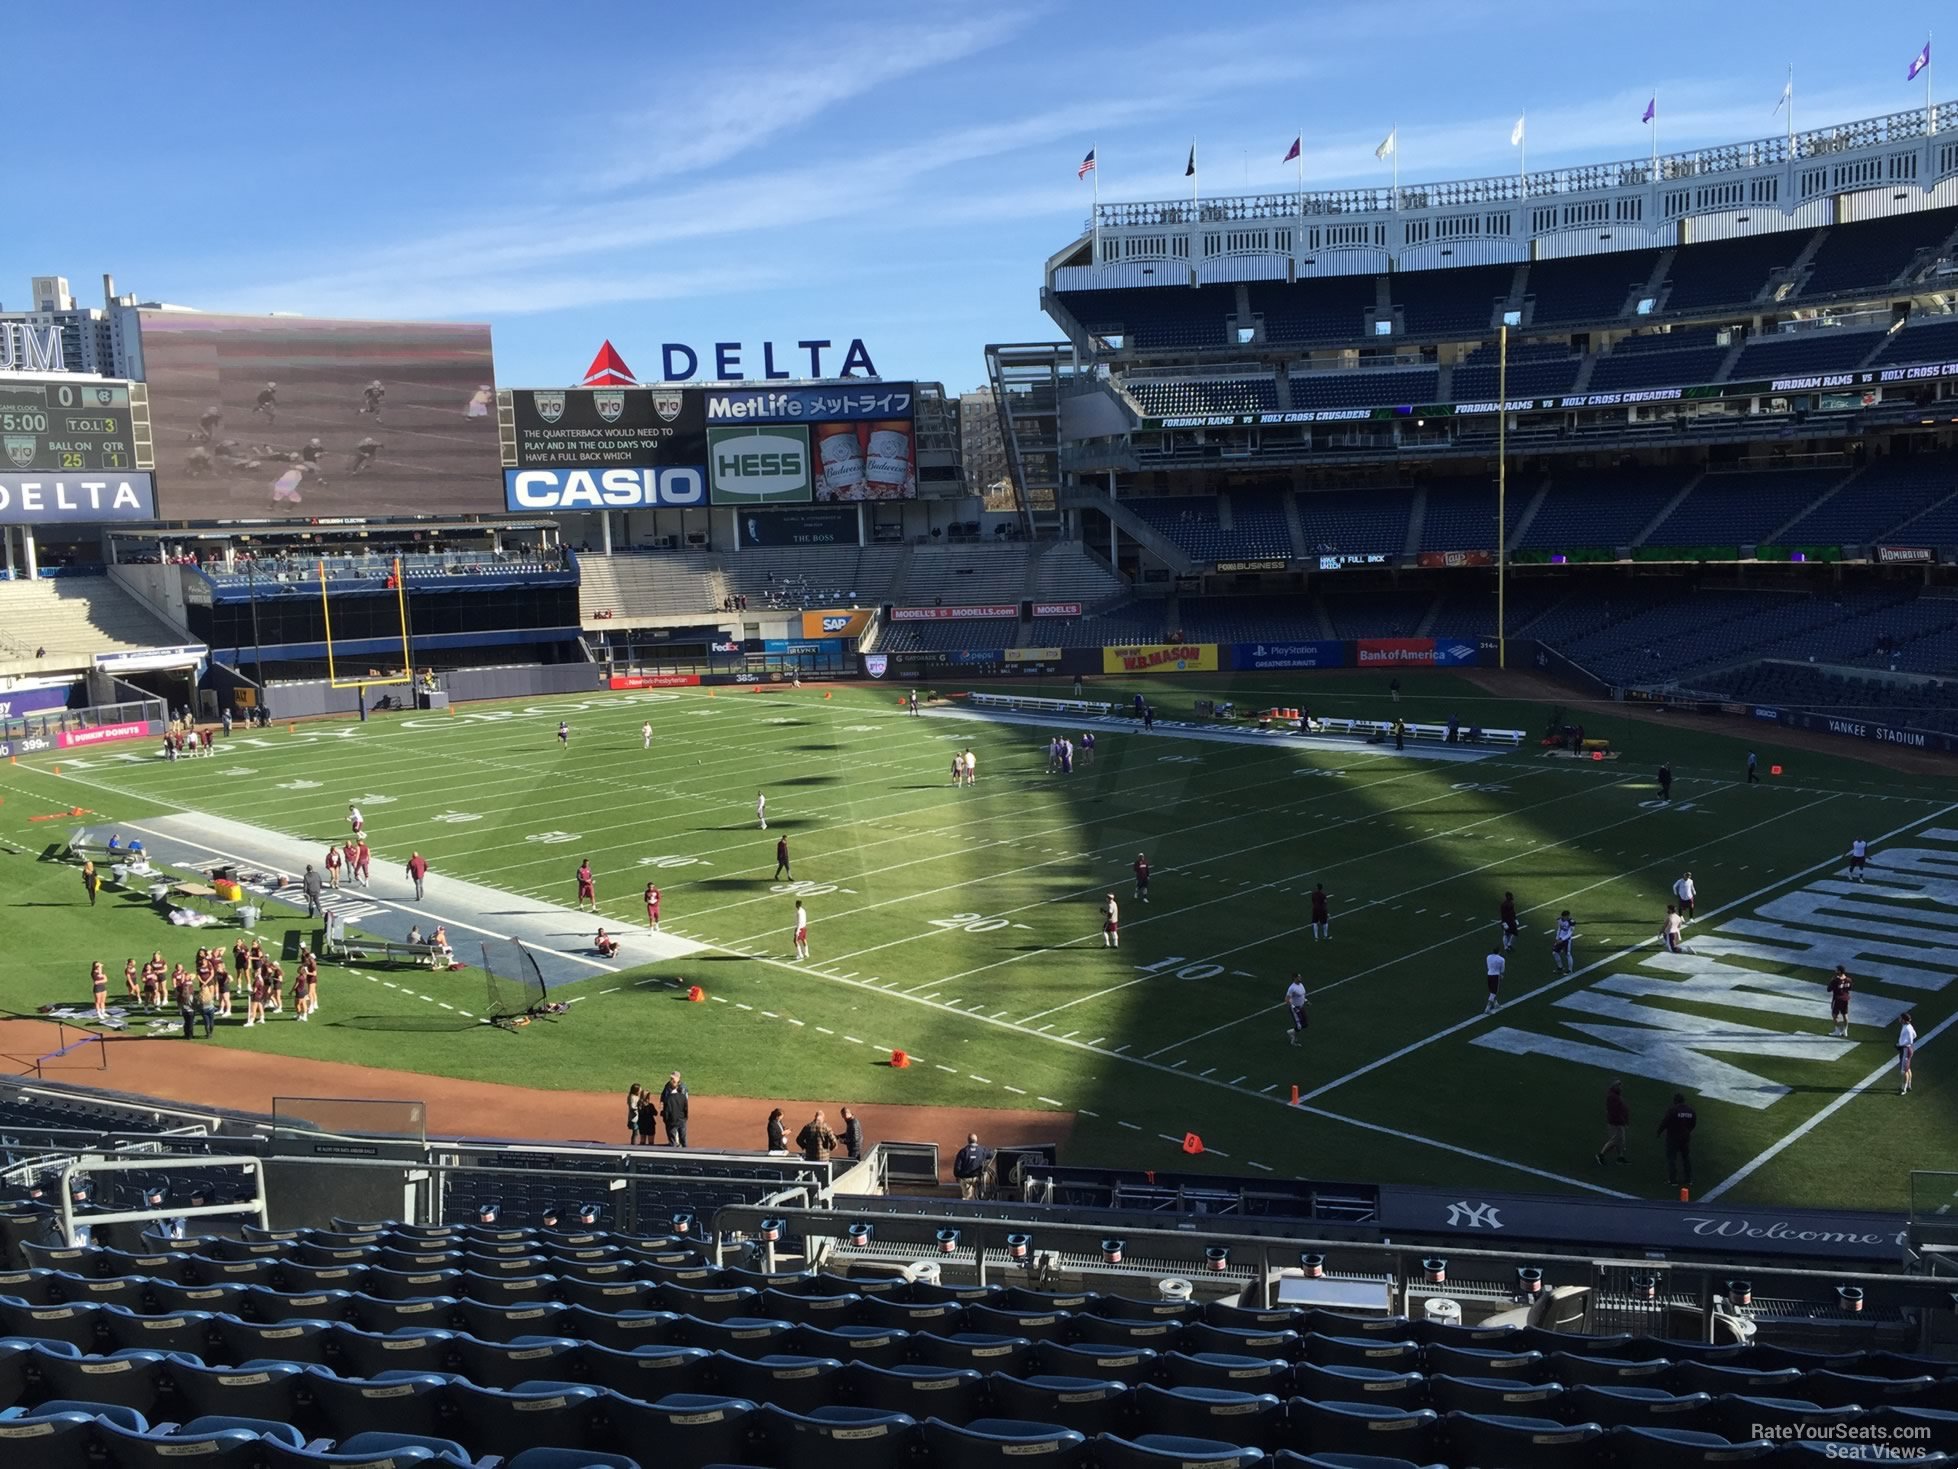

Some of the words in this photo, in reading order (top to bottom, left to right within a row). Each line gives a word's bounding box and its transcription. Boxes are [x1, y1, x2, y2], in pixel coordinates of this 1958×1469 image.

[661, 338, 878, 382] DELTA
[1771, 377, 1822, 391] FORDHAM
[1823, 374, 1853, 387] RAMS
[1881, 368, 1906, 381] HOLY
[1906, 365, 1940, 378] CROSS
[58, 385, 73, 407] 0
[1454, 403, 1502, 415] FORDHAM
[1503, 400, 1534, 411] RAMS
[1561, 397, 1587, 407] HOLY
[1588, 394, 1622, 405] CROSS
[1622, 389, 1682, 403] CRUSADERS
[708, 393, 803, 418] MetLife
[809, 393, 910, 415] メットライフ
[1161, 418, 1206, 428] FORDHAM
[1207, 416, 1235, 426] RAMS
[1260, 413, 1283, 423] HOLY
[1284, 412, 1315, 422] CROSS
[1316, 409, 1371, 421] CRUSADERS
[105, 419, 115, 432] 3
[523, 429, 541, 438] THE
[542, 429, 603, 438] QUARTERBACK
[604, 428, 635, 437] WOULD
[637, 428, 660, 437] NEED
[661, 427, 674, 436] TO
[49, 441, 72, 451] BALL
[74, 441, 92, 451] ON
[102, 442, 124, 451] QTR
[524, 442, 545, 450] PLAY
[546, 441, 565, 450] AND
[567, 441, 577, 450] IN
[578, 441, 597, 450] THE
[597, 440, 615, 449] OLD
[616, 440, 639, 449] DAYS
[639, 439, 658, 448] YOU
[62, 453, 83, 467] 25
[110, 454, 119, 467] 1
[525, 453, 548, 462] HAVE
[550, 453, 556, 461] A
[558, 452, 577, 461] FULL
[579, 452, 601, 460] BACK
[602, 451, 632, 460] WHICH
[719, 453, 801, 477] HESS
[514, 468, 701, 508] CASIO
[793, 535, 811, 543] THE
[812, 534, 834, 542] BOSS
[1236, 560, 1286, 571] BUSINESS
[1320, 556, 1337, 565] HAVE
[1349, 556, 1365, 564] FULL
[1367, 555, 1385, 564] BACK
[895, 609, 937, 618] MODELL'S
[951, 606, 1015, 617] MODELLS.com
[1037, 605, 1077, 615] MODELL'S
[823, 618, 847, 631] SAP
[711, 642, 740, 651] FedEx
[1271, 645, 1318, 655] PlayStation
[970, 652, 994, 661] pepsi
[1360, 650, 1387, 661] Bank
[1388, 649, 1400, 660] of
[1400, 649, 1446, 661] America
[1255, 660, 1290, 668] GREATNESS
[105, 726, 139, 737] DONUTS
[1828, 719, 1866, 737] YANKEE
[1876, 730, 1925, 747] STADIUM
[769, 880, 839, 897] 30
[928, 912, 1010, 932] 20
[1134, 956, 1225, 980] 10
[1682, 1216, 1884, 1247] Welcome
